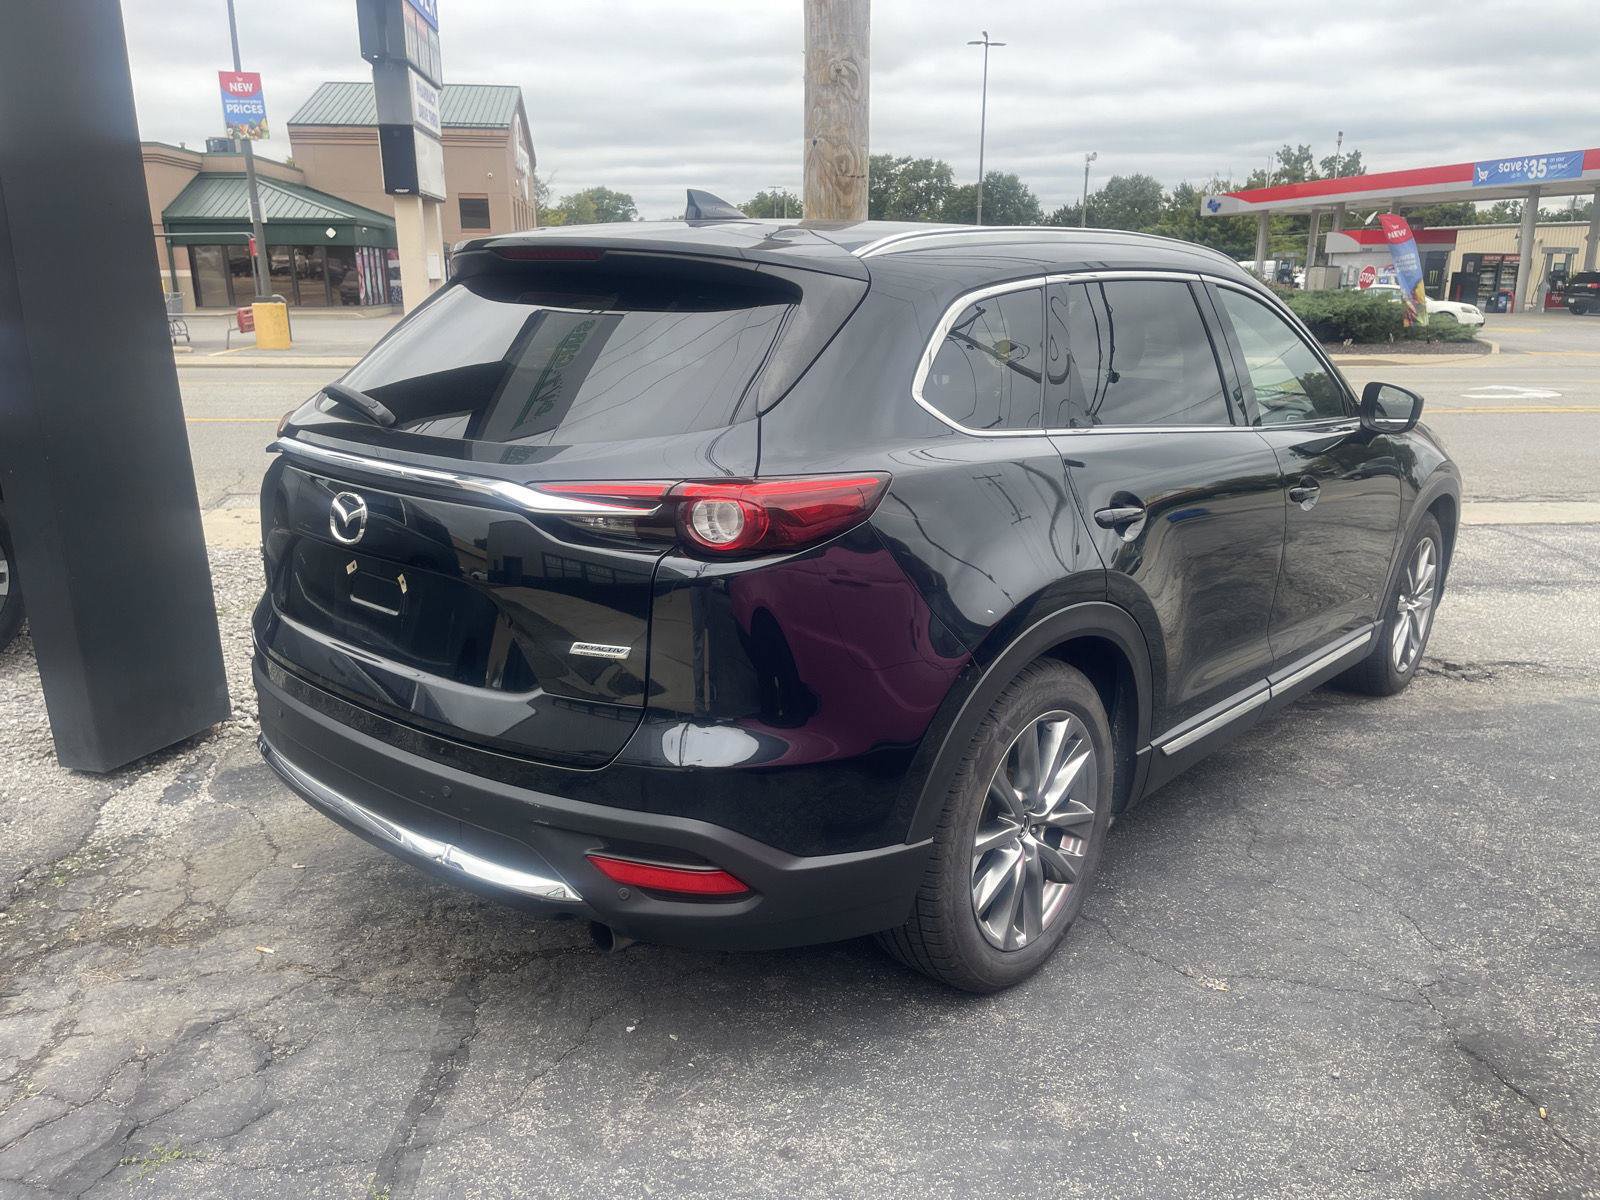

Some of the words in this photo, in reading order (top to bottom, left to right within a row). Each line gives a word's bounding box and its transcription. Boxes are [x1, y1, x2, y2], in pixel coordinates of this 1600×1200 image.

[229, 82, 254, 92] NEW
[226, 103, 264, 114] PRICES
[1498, 161, 1522, 173] save
[1523, 158, 1548, 179] $35
[1387, 228, 1407, 239] NEW
[1360, 272, 1375, 283] STOP
[574, 644, 626, 653] SKYACTIV
